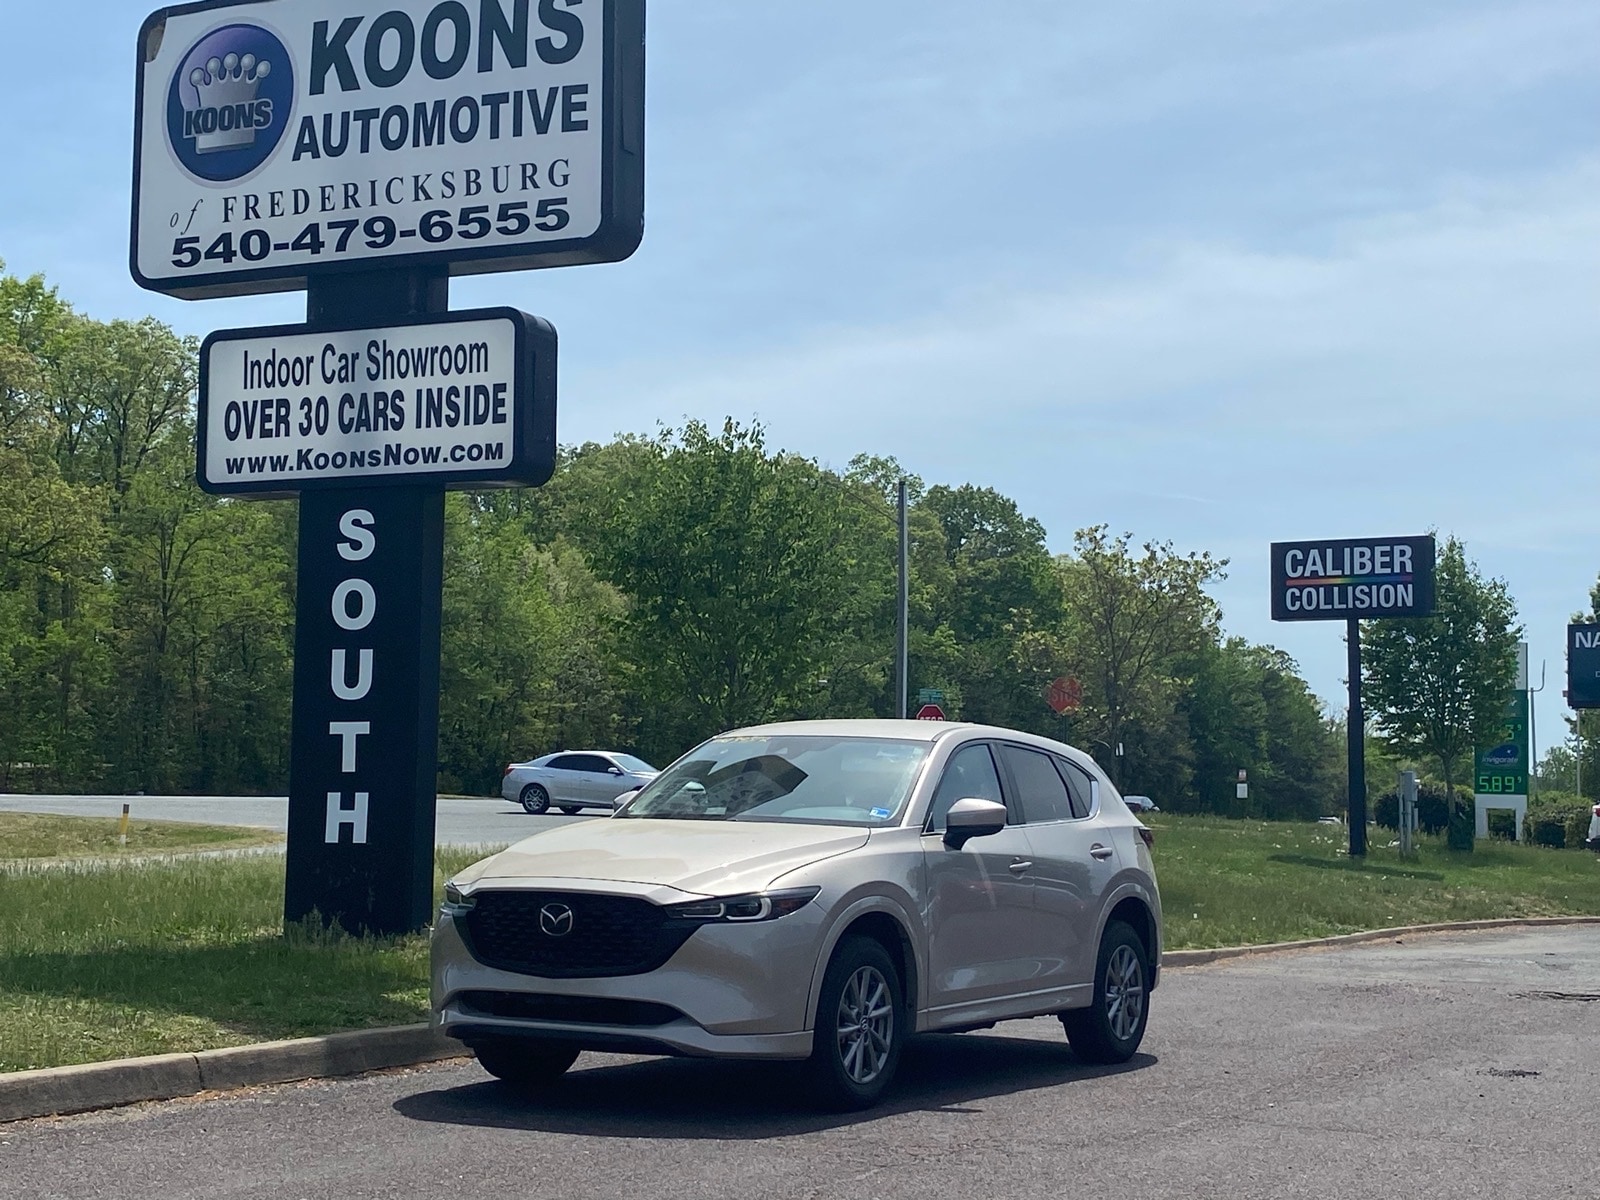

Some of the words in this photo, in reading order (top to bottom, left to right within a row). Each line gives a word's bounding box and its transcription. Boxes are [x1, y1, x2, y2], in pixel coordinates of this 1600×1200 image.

[309, 0, 584, 95] KOONS
[184, 99, 272, 137] KOONS
[292, 84, 589, 161] AUTOMOTIVE
[169, 198, 204, 236] of
[222, 158, 571, 223] FREDERICKSBURG
[172, 197, 571, 268] 540-479-6555
[243, 348, 314, 390] Indoor
[321, 343, 360, 385] Car
[366, 339, 489, 381] Showroom
[224, 397, 291, 442] OVER
[298, 395, 329, 437] 30
[338, 389, 405, 434] CARS
[415, 383, 507, 429] INSIDE
[1285, 544, 1413, 578] CALIBER
[1286, 583, 1414, 611] COLLISION
[324, 508, 377, 844] SOUTH
